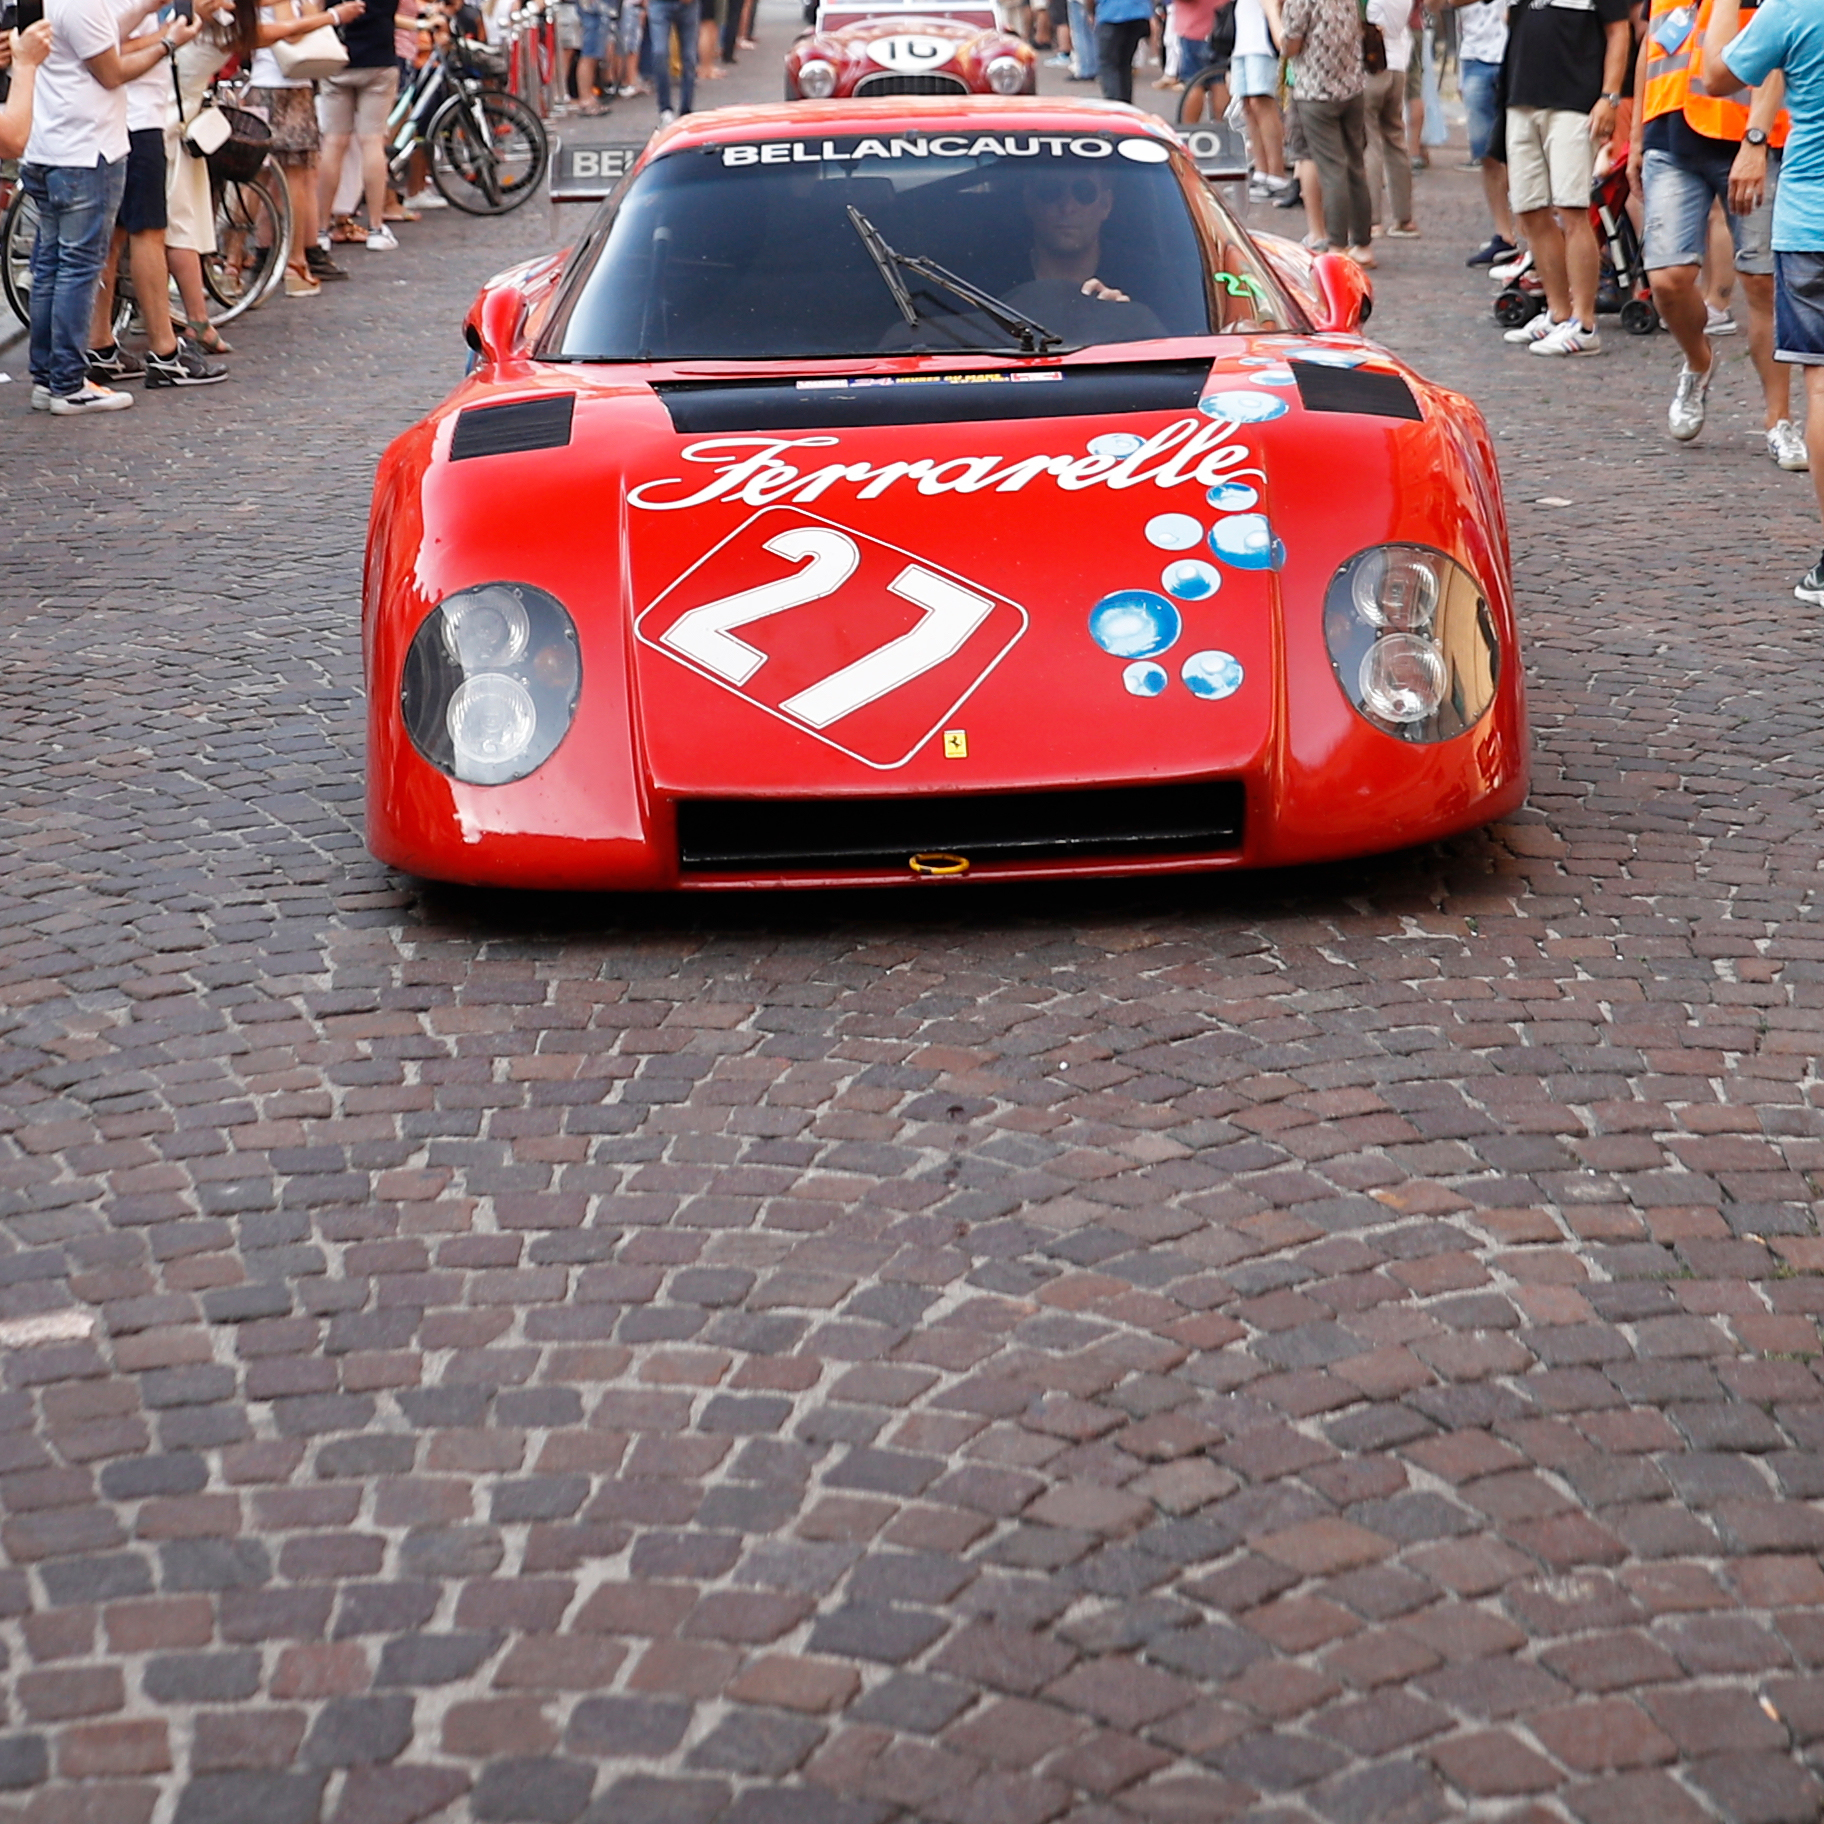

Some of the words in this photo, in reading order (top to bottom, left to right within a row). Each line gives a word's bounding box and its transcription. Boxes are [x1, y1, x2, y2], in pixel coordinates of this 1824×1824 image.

[888, 40, 938, 61] 16
[721, 136, 1115, 168] BELLANCAUTO
[626, 417, 1269, 511] Ferrarelle
[658, 526, 997, 732] 27
